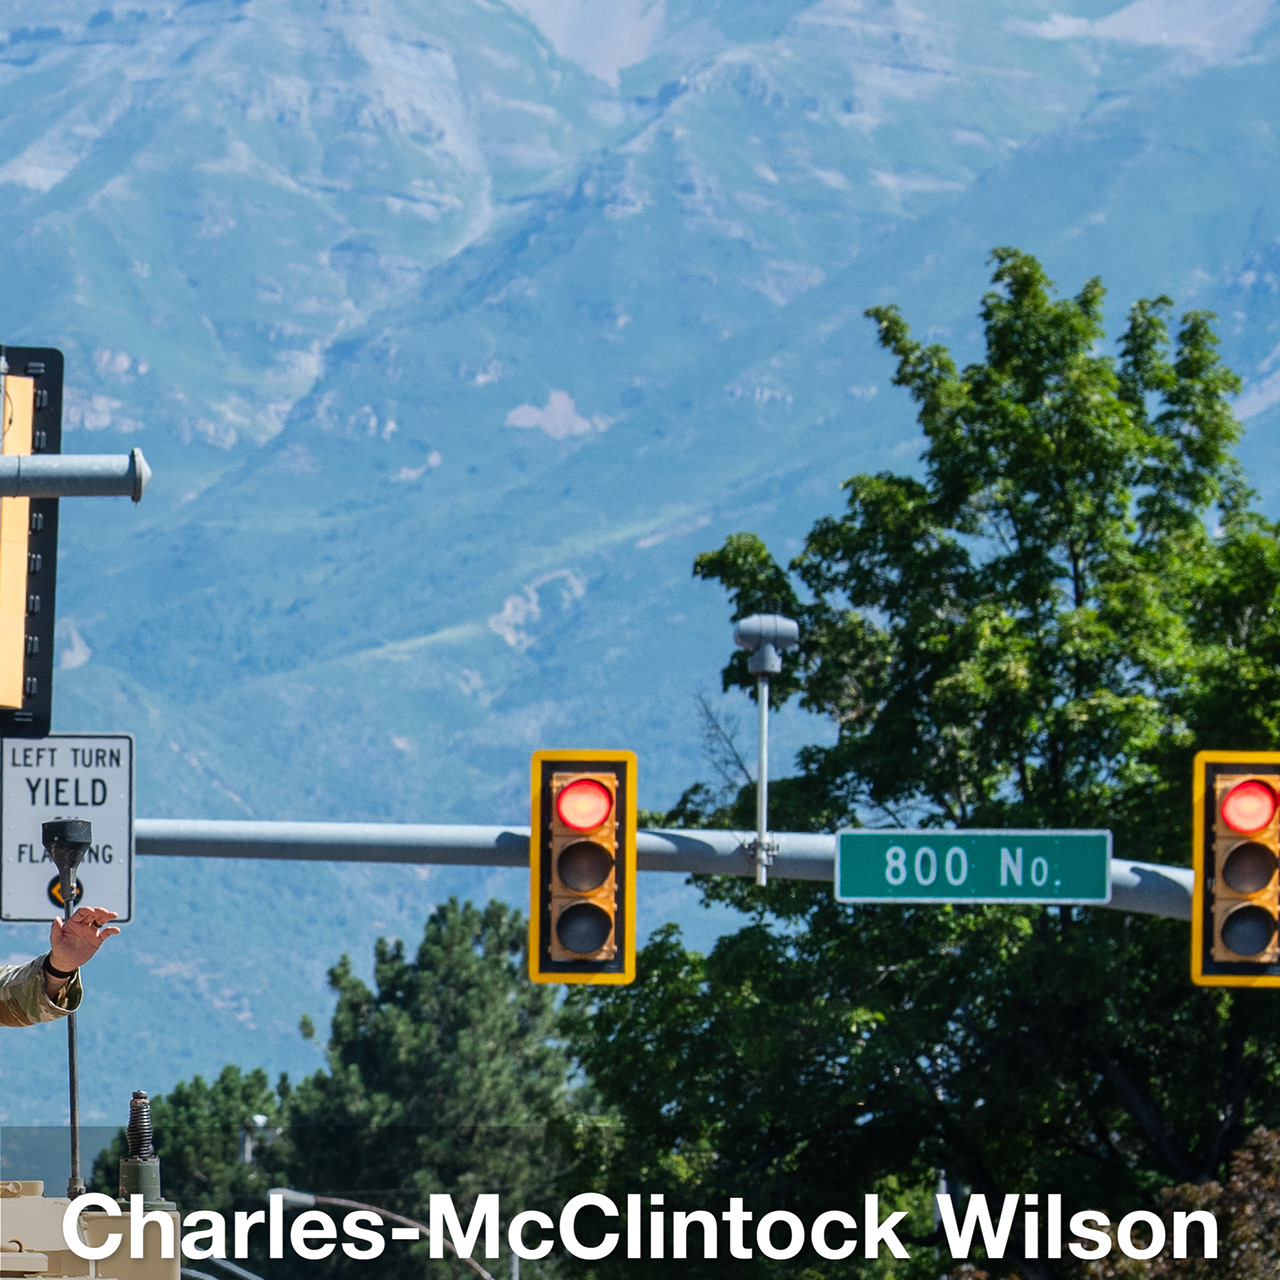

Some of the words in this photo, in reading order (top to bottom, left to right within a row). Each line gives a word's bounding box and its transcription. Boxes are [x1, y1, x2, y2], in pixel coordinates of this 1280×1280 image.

[12, 747, 57, 768] LEFT
[72, 747, 121, 768] TURN
[26, 777, 107, 806] YIELD
[18, 843, 113, 864] FLANG
[885, 845, 968, 886] 800
[1000, 846, 1062, 887] No.
